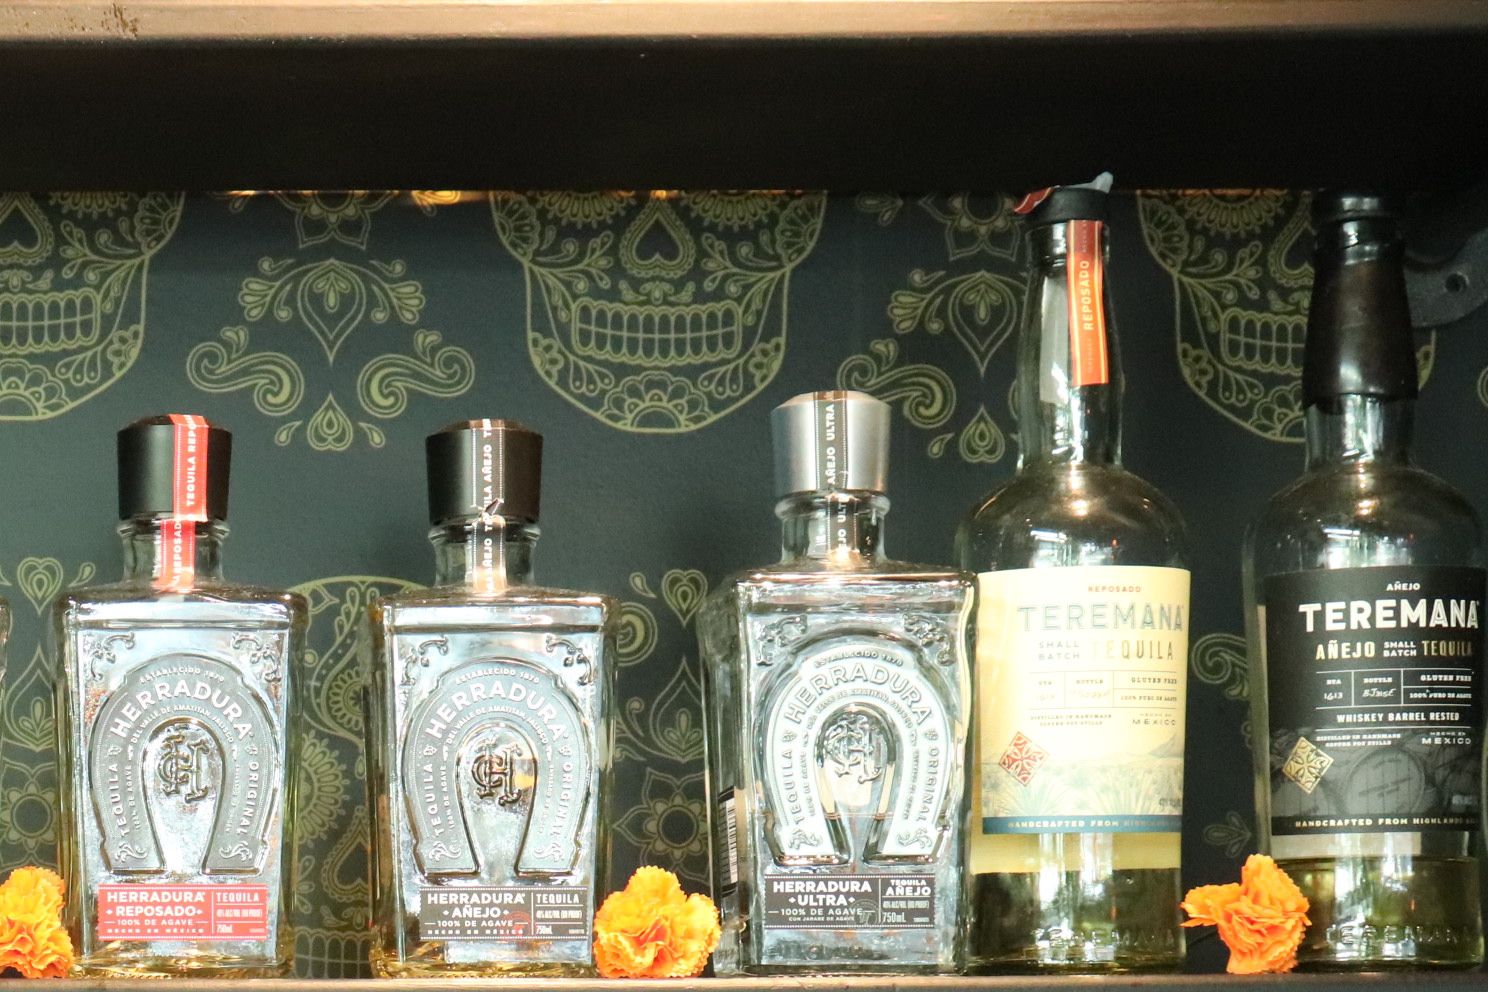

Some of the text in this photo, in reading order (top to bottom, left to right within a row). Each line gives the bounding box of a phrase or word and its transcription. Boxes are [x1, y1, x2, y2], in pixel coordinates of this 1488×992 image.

[1079, 260, 1095, 331] REPOSADO
[825, 404, 836, 485] AÑEJO ULTRA
[186, 456, 197, 508] TEQUILA
[1087, 585, 1142, 593] REPOSADO
[1385, 580, 1421, 592] AÑEJO
[1017, 602, 1183, 632] TEREMANA
[1298, 598, 1479, 633] TEREMANA
[1038, 640, 1080, 649] SMALL
[1315, 639, 1473, 660] AÑEJO SMALL TEQUILA
[815, 650, 878, 669] ESTABLECIDO
[1038, 652, 1080, 661] BATCH
[1383, 649, 1417, 658] BATCH
[139, 667, 201, 684] ESTABLECIDO
[455, 668, 516, 685] ESTABLECIDO
[1420, 674, 1454, 682] GLUTEN
[784, 662, 933, 726] HERRADURA
[110, 679, 253, 740] HERRADURA
[161, 705, 173, 715] DE
[425, 680, 566, 742] HERRADURA
[476, 707, 487, 716] DE
[1132, 719, 1176, 727] MEXICO
[1336, 712, 1460, 723] WHISKEY BARREL RESTED
[1421, 737, 1471, 745] MEXICO
[439, 765, 449, 793] AGAVE
[916, 748, 940, 822] ORIGINAL
[781, 750, 805, 825] TEQUILA
[108, 763, 131, 837] TEQUILA
[236, 761, 259, 835] ORIGINAL
[423, 763, 445, 838] TEQUILA
[1007, 820, 1085, 828] HANDCRAFTED
[1090, 819, 1119, 827] FROM
[1295, 818, 1373, 828] HANDCRAFTED
[1378, 817, 1408, 826] FROM
[773, 880, 872, 893] HERRADURA
[885, 884, 932, 896] AÑEJO
[107, 891, 205, 903] HERRADURA
[216, 892, 260, 903] TEQUILA
[427, 892, 525, 904] HERRADURA
[536, 893, 580, 904] TEQUILA
[797, 894, 848, 907] ULTRA
[116, 905, 197, 917] REPOSADO
[452, 904, 501, 919] AÑEJO
[781, 908, 863, 916] 100% DE AGAVE
[882, 911, 906, 923] 750mL
[437, 920, 513, 928] 100% DE AGAVE
